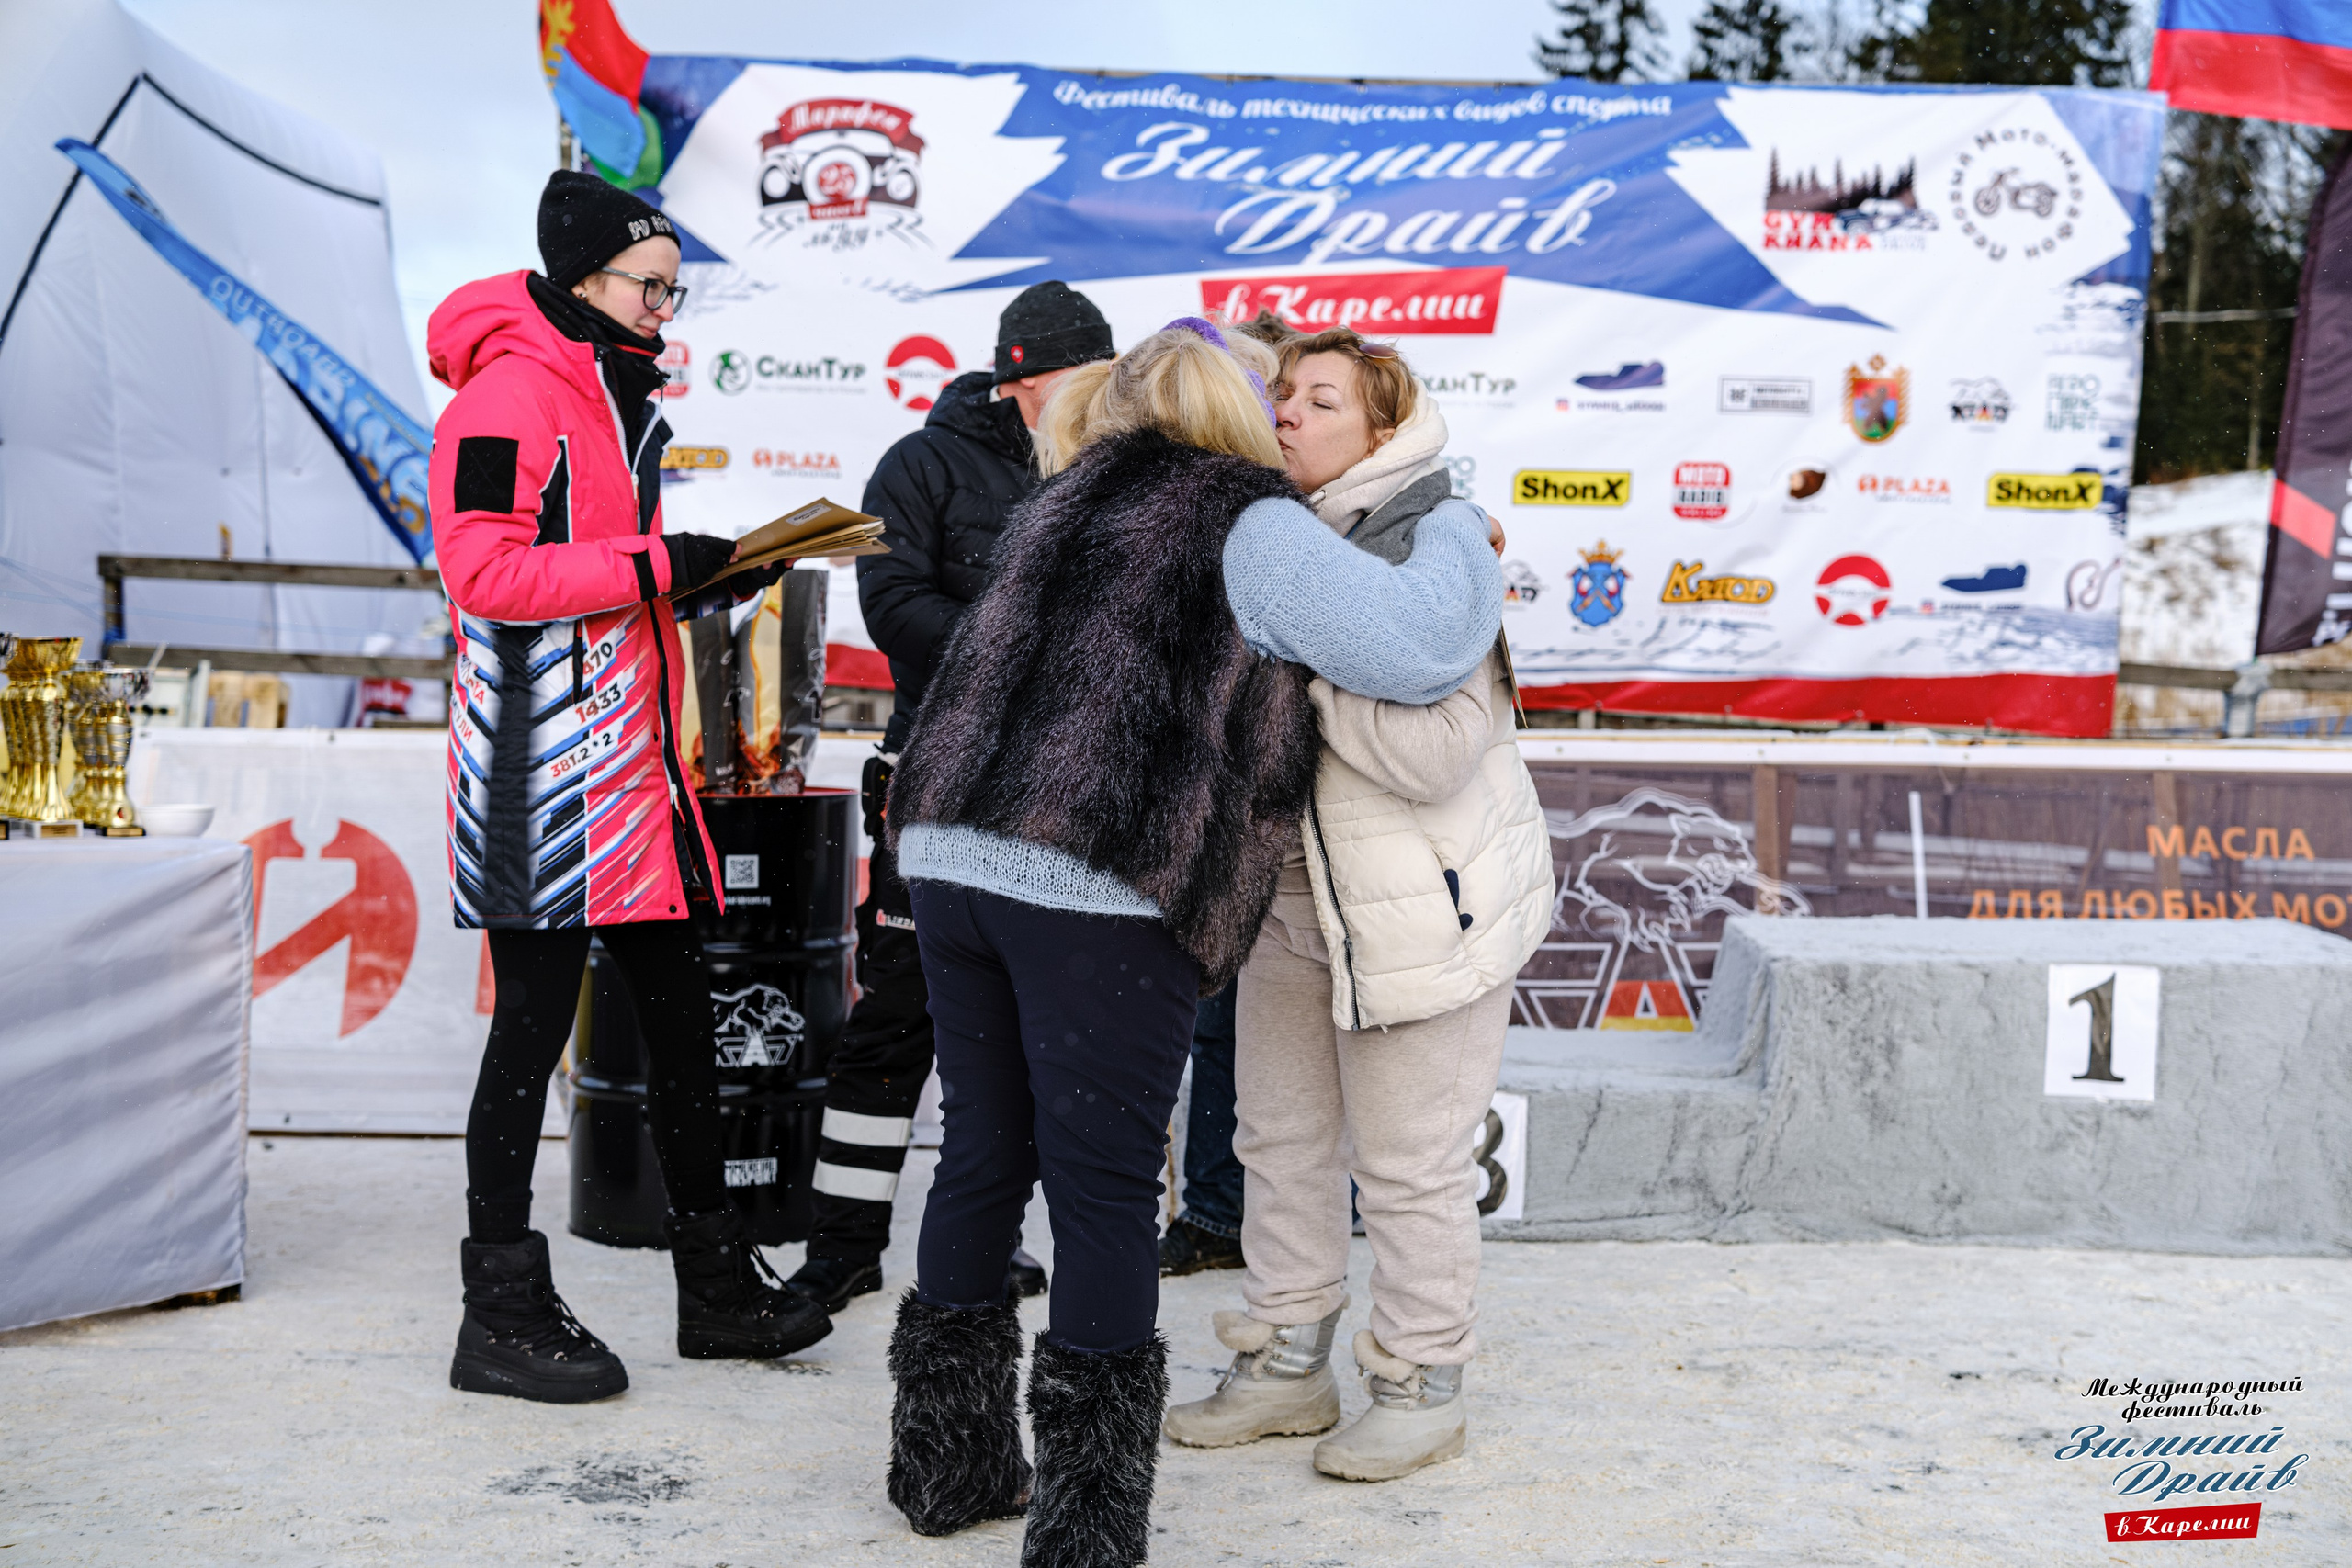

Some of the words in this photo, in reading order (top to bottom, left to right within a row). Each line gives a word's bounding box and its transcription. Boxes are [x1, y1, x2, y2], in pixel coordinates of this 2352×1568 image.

[1053, 79, 1237, 120] Фестиваль
[1453, 90, 1547, 124] видов
[1551, 94, 1674, 123] спорта
[1102, 121, 1569, 184] Зимний
[1214, 180, 1617, 265] Драйв
[1257, 284, 1487, 328] Карелии
[1521, 476, 1625, 502] ShonX
[1995, 479, 2096, 503] ShonX
[575, 682, 621, 725] 1433
[551, 747, 592, 778] 381.2
[2146, 825, 2314, 861] МАСЛА
[1967, 889, 2064, 919] ДЛЯ
[2078, 889, 2258, 920] ЛЮБЫХ
[2272, 891, 2352, 929] МО
[2068, 973, 2126, 1085] 1
